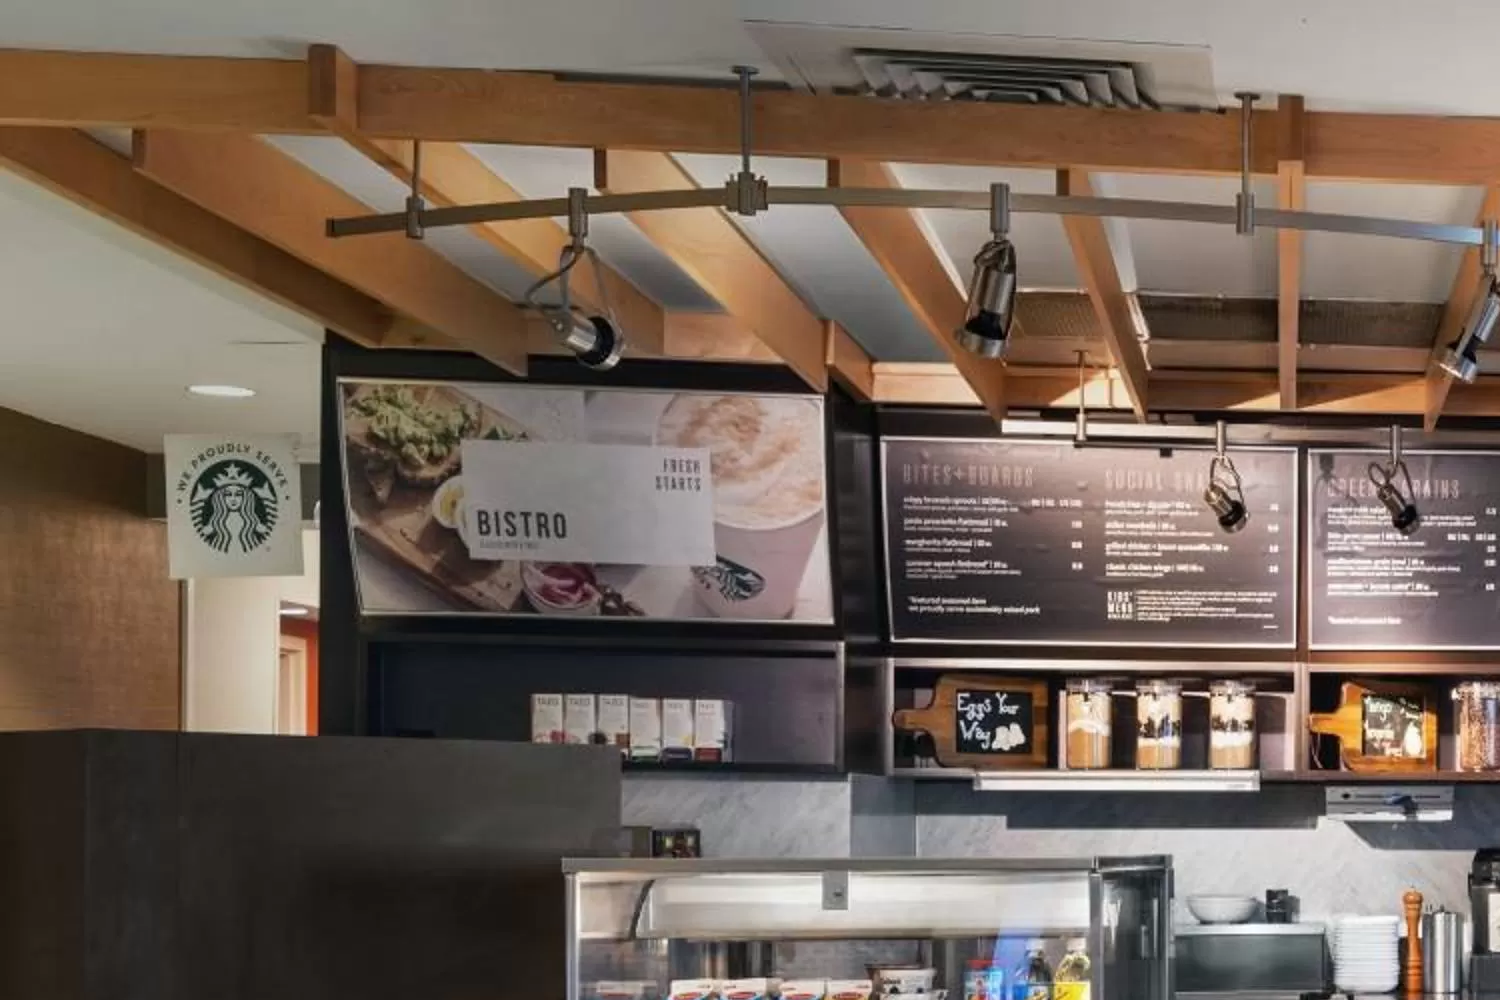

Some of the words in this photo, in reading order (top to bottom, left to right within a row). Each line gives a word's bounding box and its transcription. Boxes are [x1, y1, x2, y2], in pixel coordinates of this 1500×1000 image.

[176, 472, 191, 491] WE
[191, 442, 251, 469] PROUDLY
[255, 451, 288, 488] SERVE
[662, 458, 701, 474] FRESH
[1104, 468, 1163, 491] SOCIAL
[655, 475, 701, 492] STARTS
[476, 509, 568, 540] BISTRO
[956, 691, 993, 721] Eggs
[994, 691, 1021, 716] Your
[959, 719, 992, 749] Way
